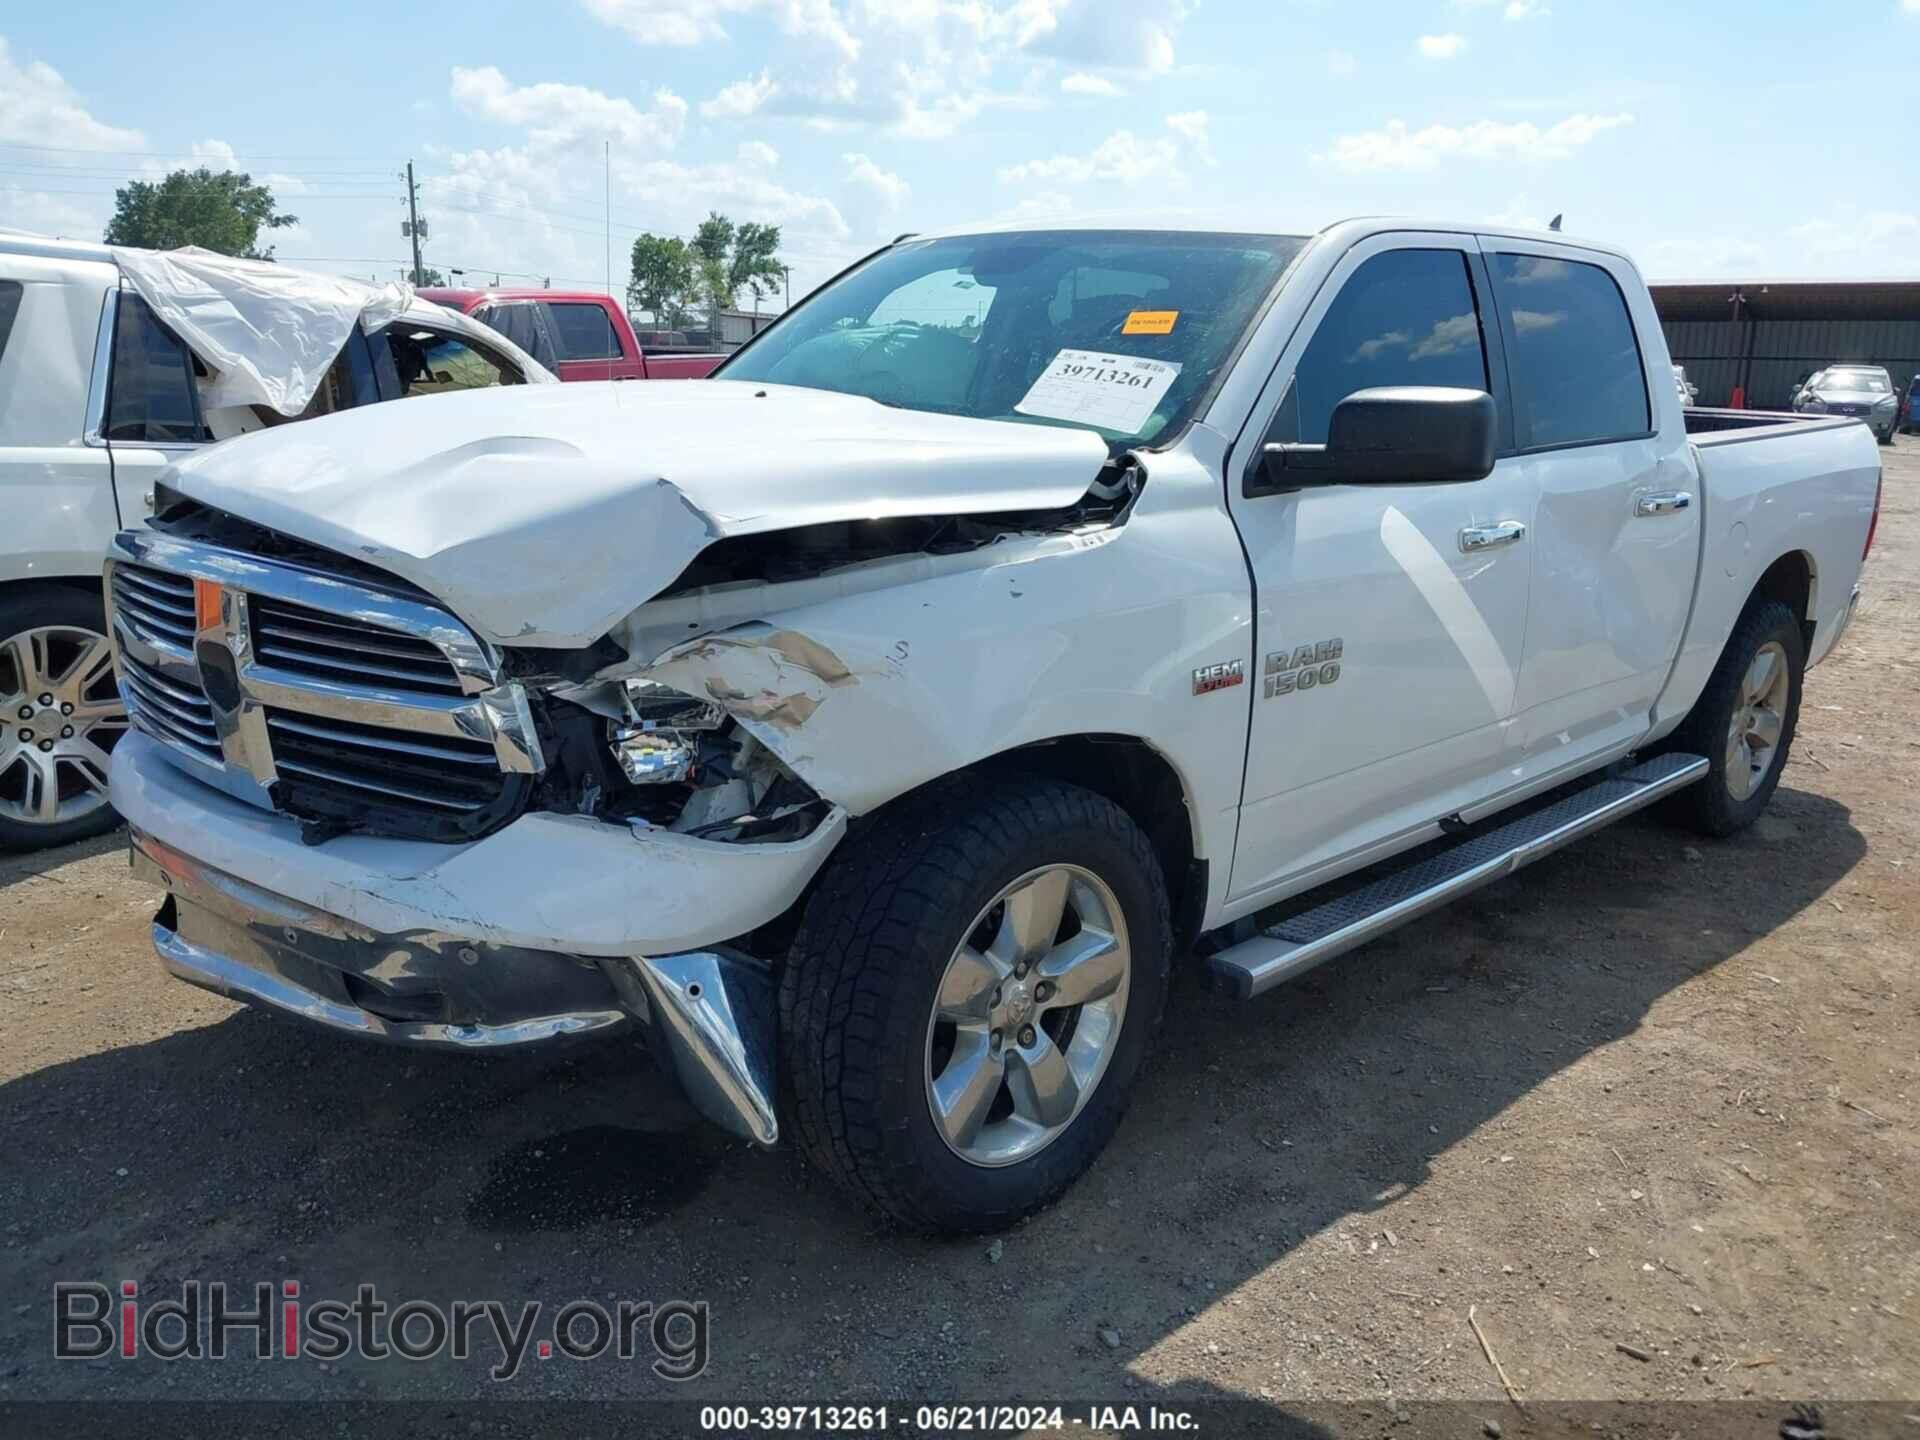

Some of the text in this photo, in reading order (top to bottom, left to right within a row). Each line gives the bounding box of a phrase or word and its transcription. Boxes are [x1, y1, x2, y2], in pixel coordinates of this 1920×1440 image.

[1056, 363, 1154, 389] 39713261
[1192, 659, 1243, 682] HEMI
[1264, 638, 1343, 675] RAM
[1264, 661, 1341, 699] 1500
